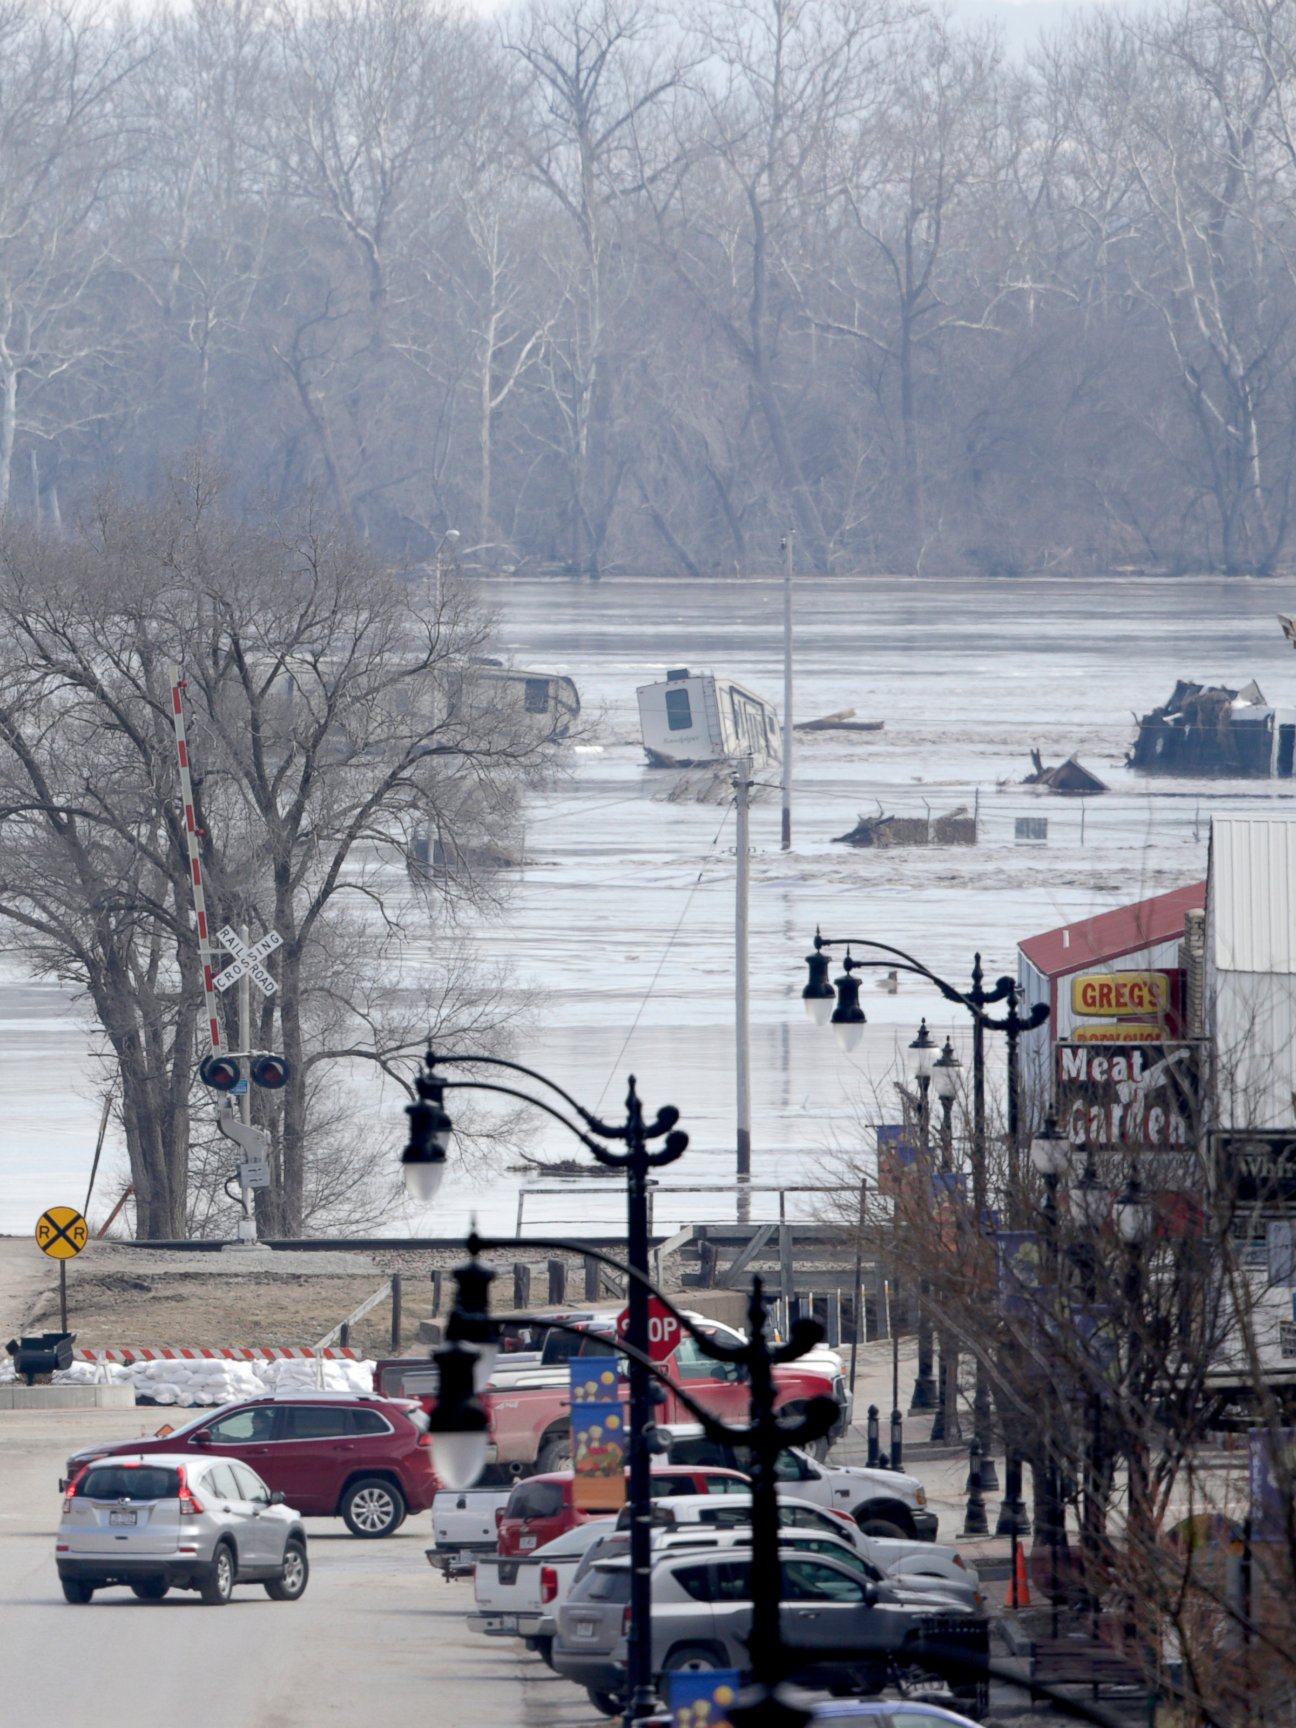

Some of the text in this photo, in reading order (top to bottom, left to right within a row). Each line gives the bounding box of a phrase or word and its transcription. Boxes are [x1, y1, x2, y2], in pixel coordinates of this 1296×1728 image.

[216, 934, 280, 988] CROSSING
[1081, 982, 1160, 1008] GREG'S
[1058, 1047, 1144, 1082] Meat
[39, 1226, 85, 1240] R R
